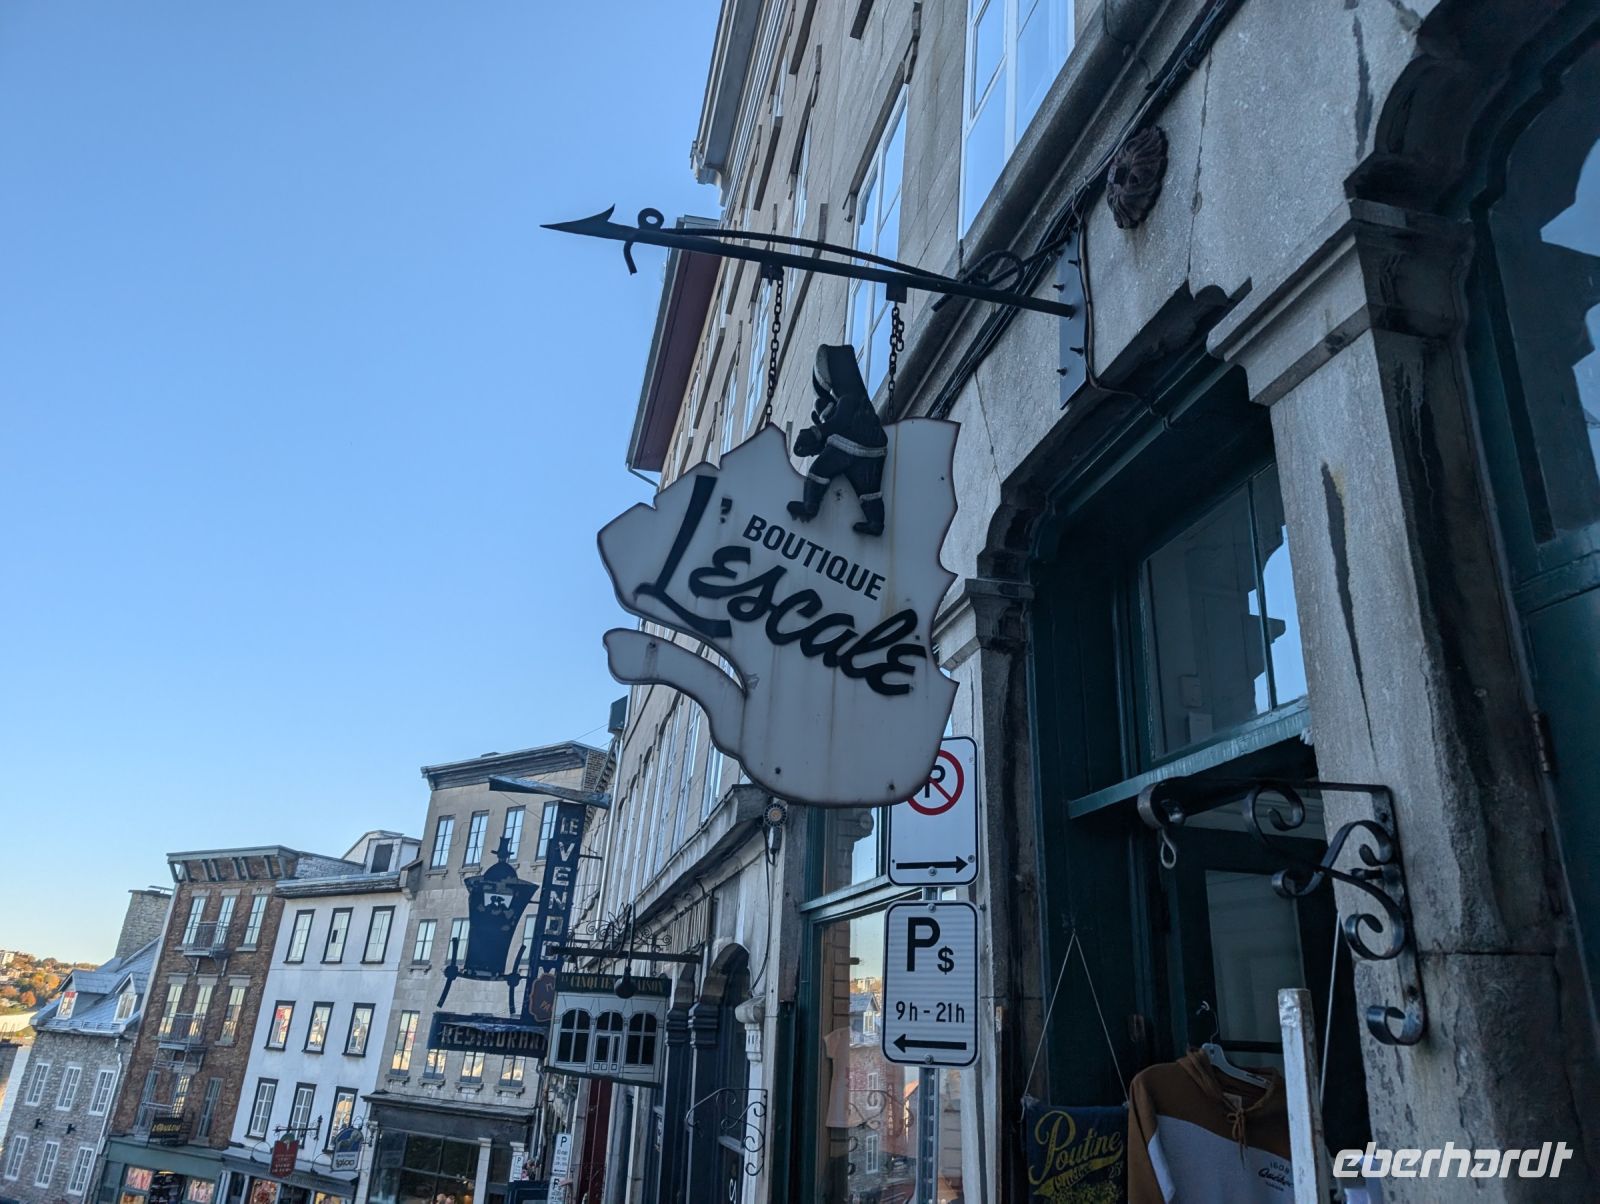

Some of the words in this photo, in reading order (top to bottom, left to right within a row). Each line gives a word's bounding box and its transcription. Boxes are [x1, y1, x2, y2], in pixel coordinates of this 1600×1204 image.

[742, 514, 886, 601] BOUTIQUE
[560, 816, 578, 836] LE
[895, 1000, 919, 1022] 9h
[935, 1001, 965, 1024] 21h
[1028, 1110, 1122, 1185] Poutine
